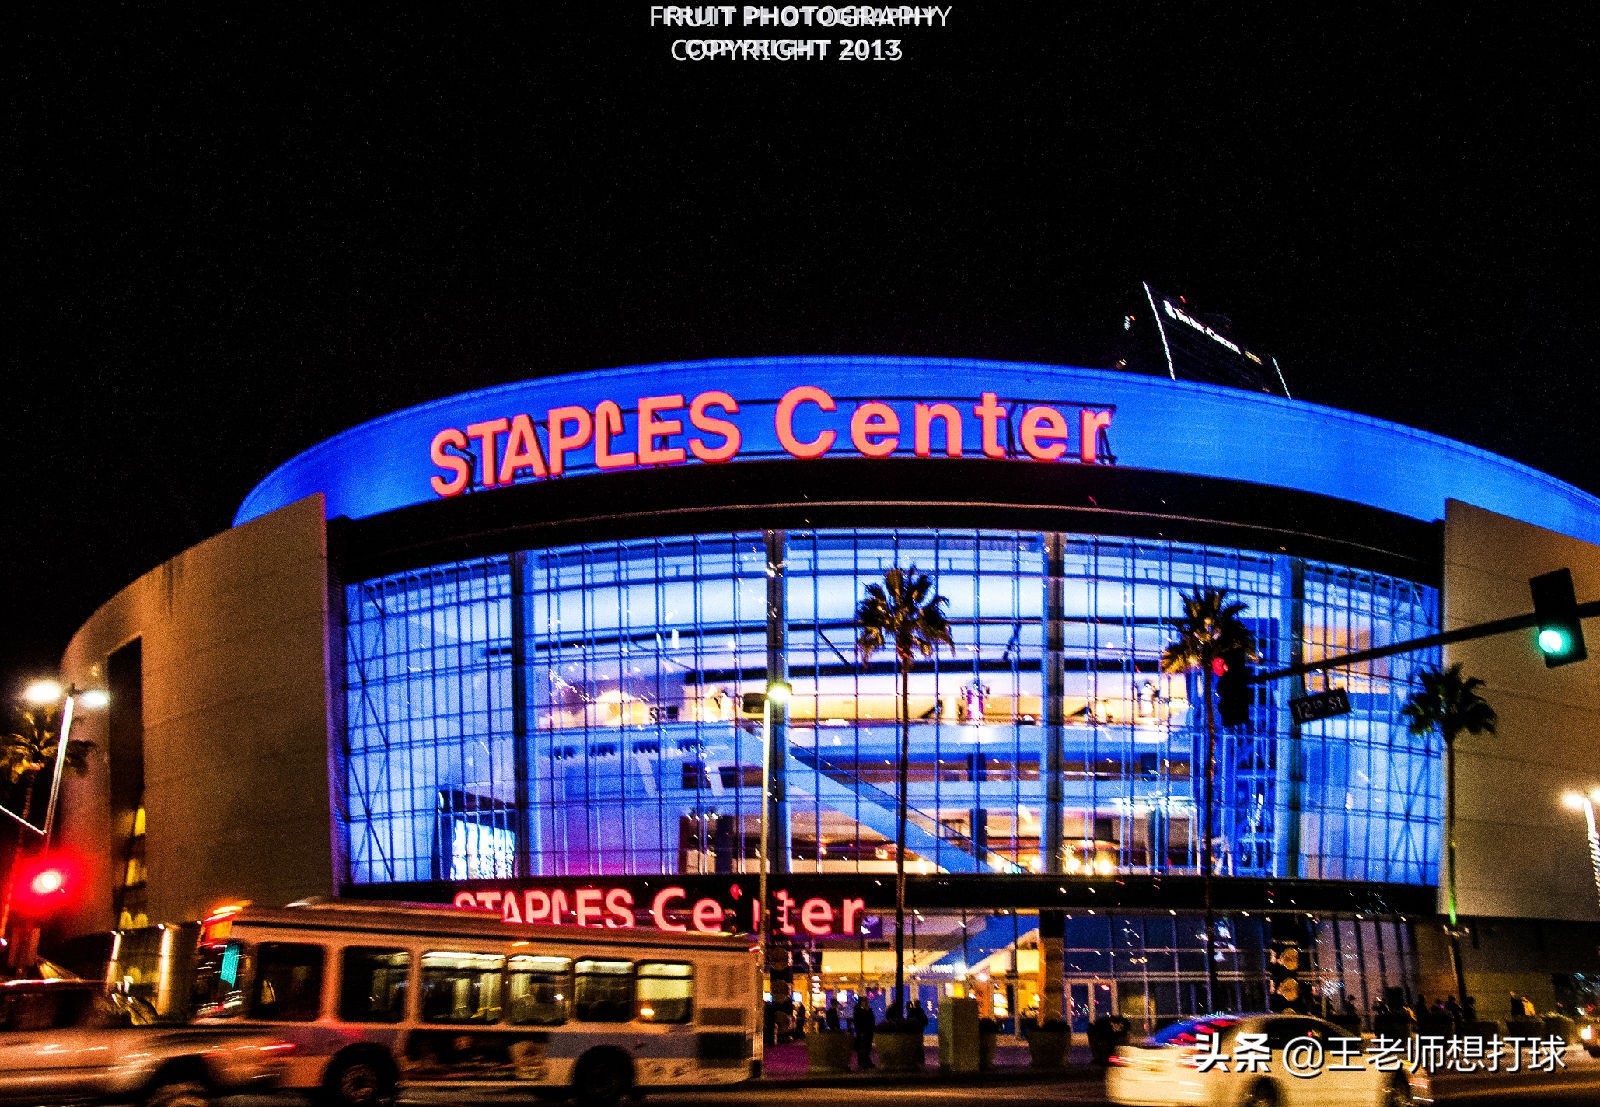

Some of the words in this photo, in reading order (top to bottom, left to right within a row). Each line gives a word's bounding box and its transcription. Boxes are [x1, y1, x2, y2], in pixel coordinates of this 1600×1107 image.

[429, 391, 742, 497] STAPLES
[775, 385, 1113, 464] Center
[650, 886, 865, 937] Ceter
